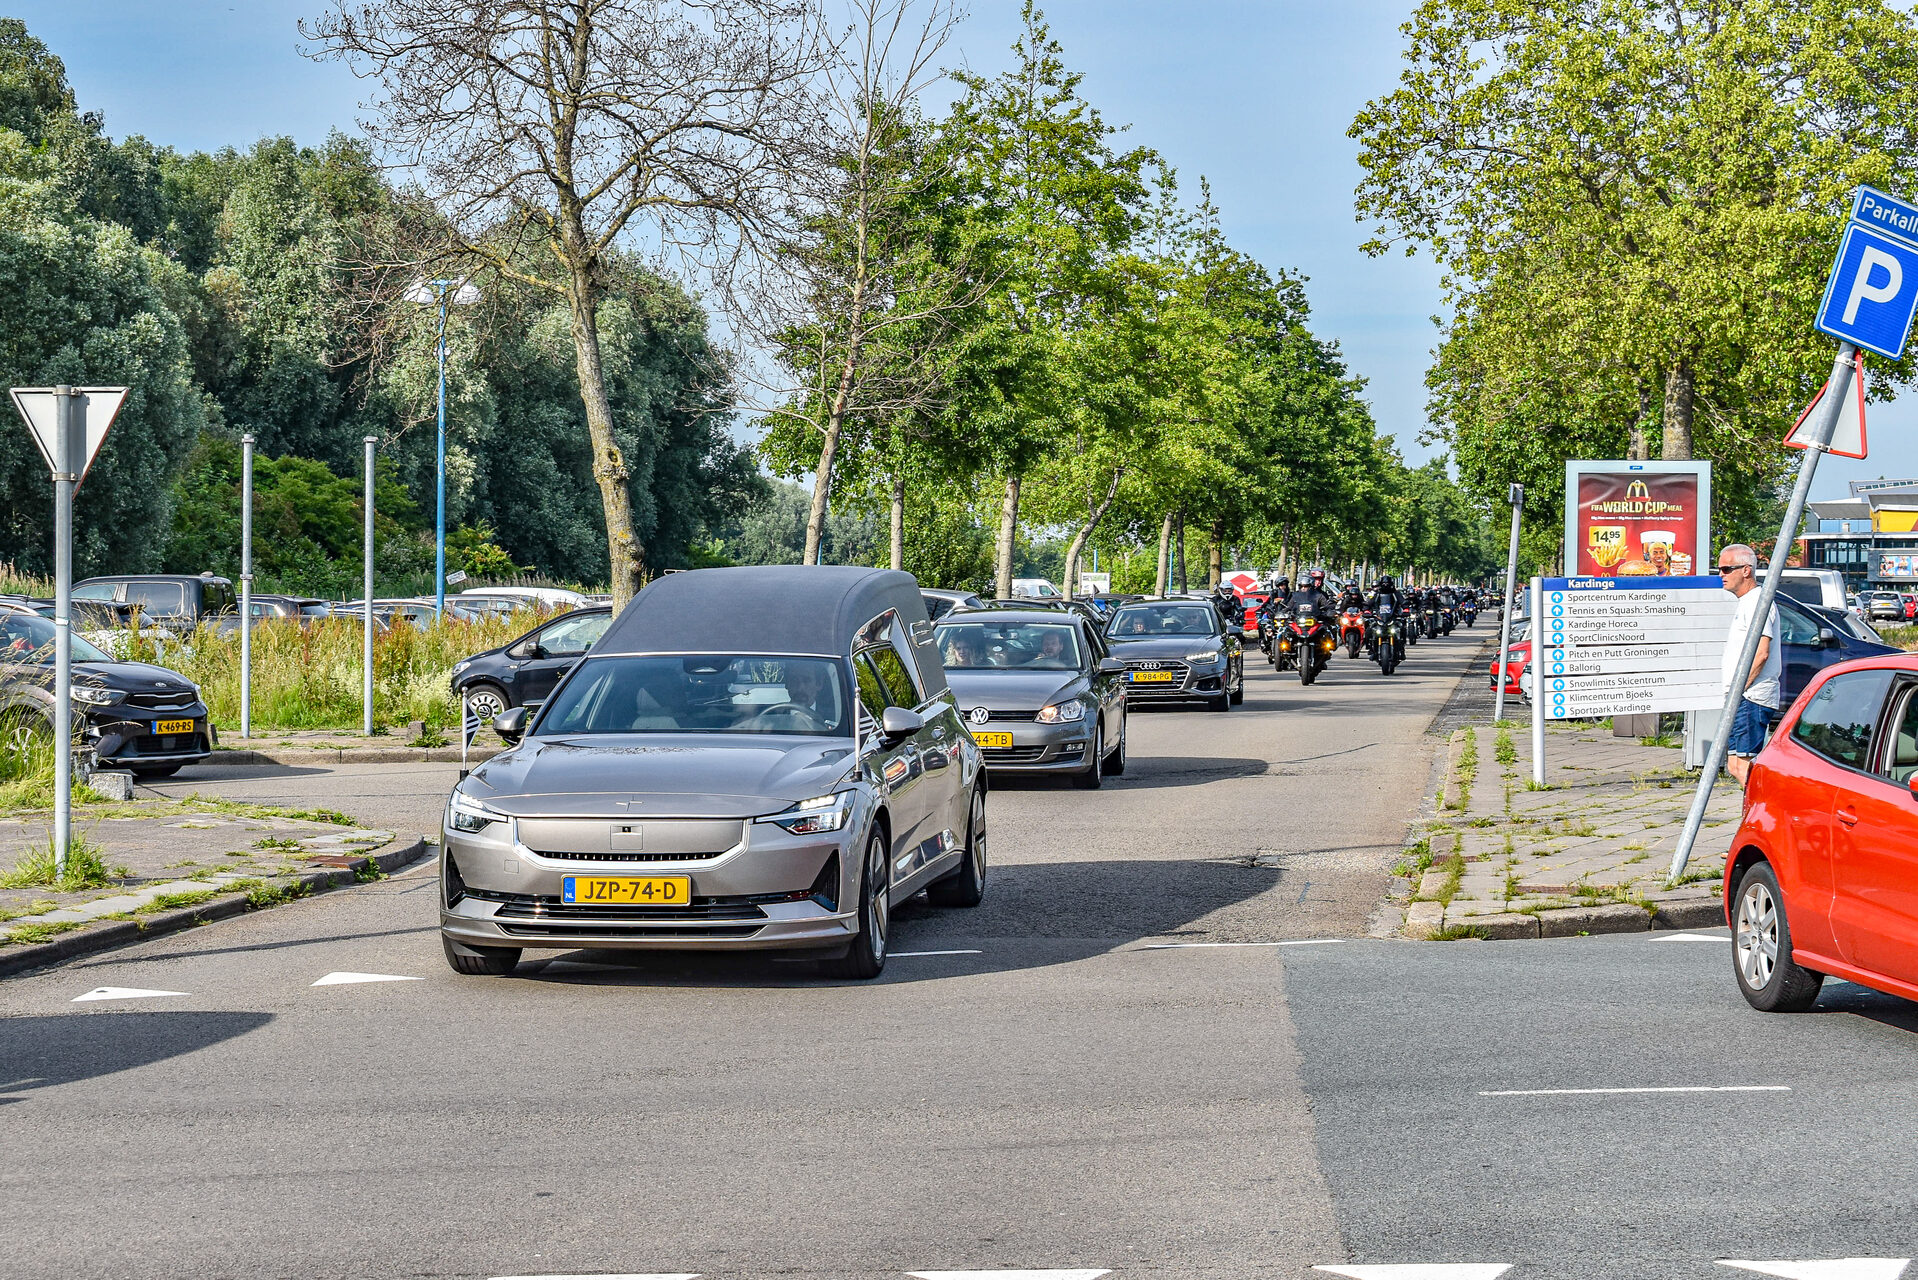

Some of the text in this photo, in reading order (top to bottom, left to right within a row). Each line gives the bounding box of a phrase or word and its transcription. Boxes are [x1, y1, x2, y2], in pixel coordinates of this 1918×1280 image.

[1861, 196, 1918, 234] Parkall
[1841, 245, 1903, 326] P
[1603, 501, 1643, 513] WORLD
[1645, 501, 1667, 514] CUP
[1568, 578, 1615, 590] Kardinge
[1568, 592, 1667, 603] Sportcentrum Kardinge
[1568, 606, 1595, 615] Tennis
[1610, 605, 1643, 615] Squash:
[1644, 605, 1686, 615] Smashing
[1568, 620, 1638, 630] Kardinge Horeca
[1568, 633, 1645, 643] SportClinicsNoord
[1569, 650, 1590, 659] Pitch
[1604, 649, 1622, 658] Putt
[1624, 648, 1669, 657] Groningen
[1569, 663, 1601, 673] Ballorig
[1569, 676, 1666, 688] Snowlimits Skicentrum
[1569, 689, 1654, 702] Klimcentrum Bjoeks
[1569, 702, 1652, 716] Sportpark Kardinge
[158, 721, 192, 733] K-469-RS
[584, 881, 676, 900] JZP-74-D
